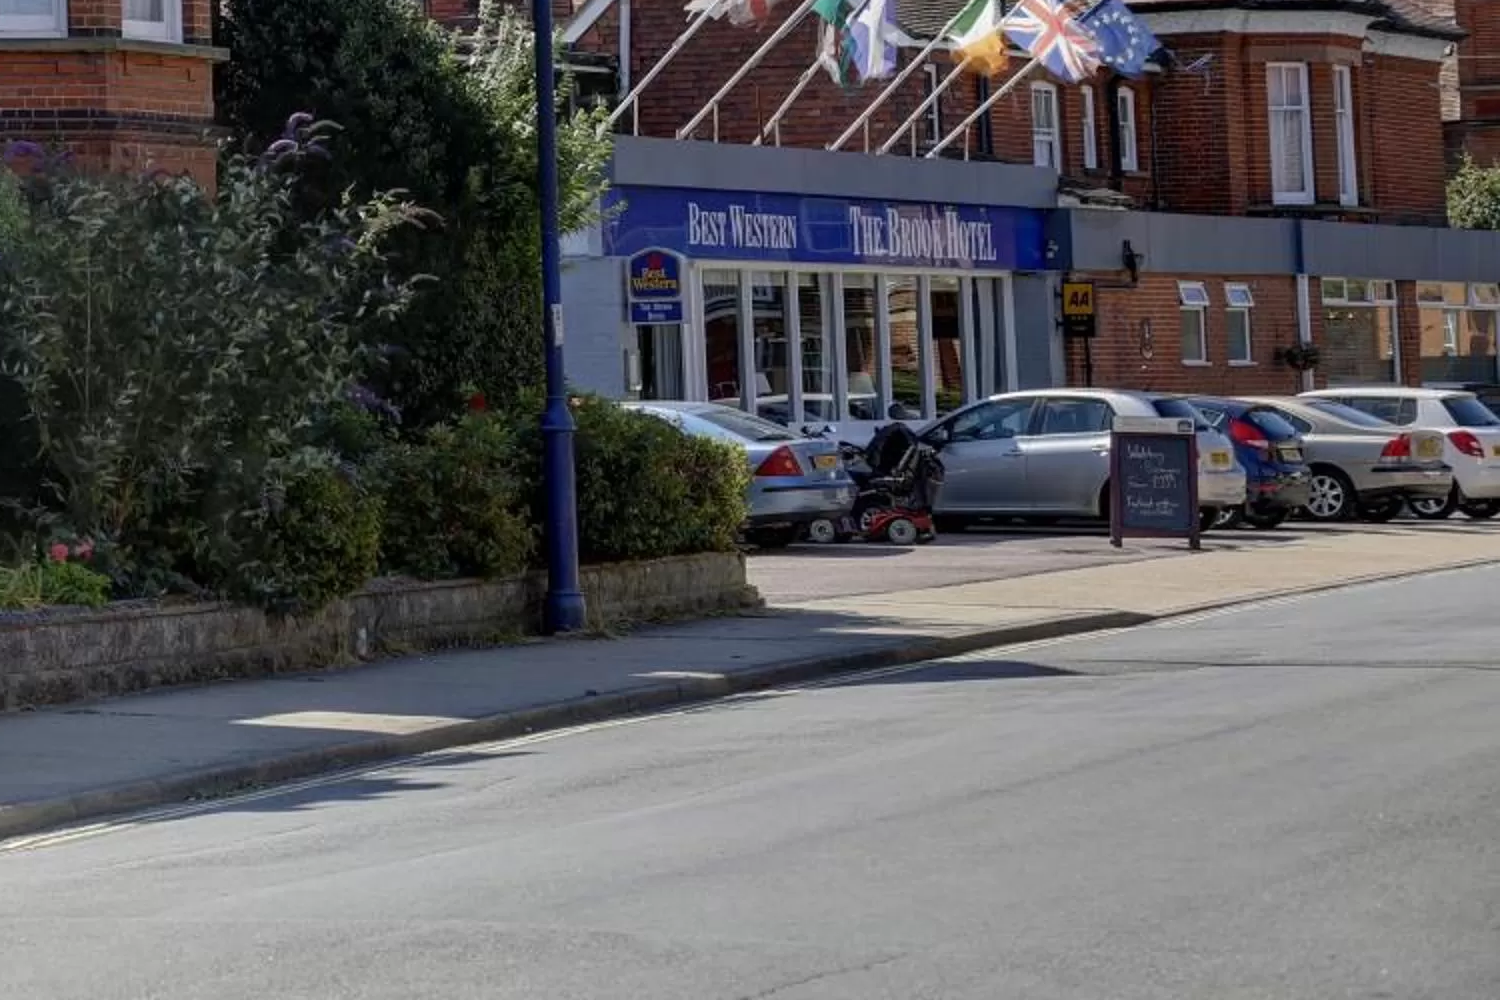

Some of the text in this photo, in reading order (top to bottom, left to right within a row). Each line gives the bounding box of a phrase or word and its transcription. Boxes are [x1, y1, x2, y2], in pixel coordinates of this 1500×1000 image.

[688, 202, 997, 261] BEST WESTERN THE BROOK HOTEL
[1069, 291, 1089, 308] AA
